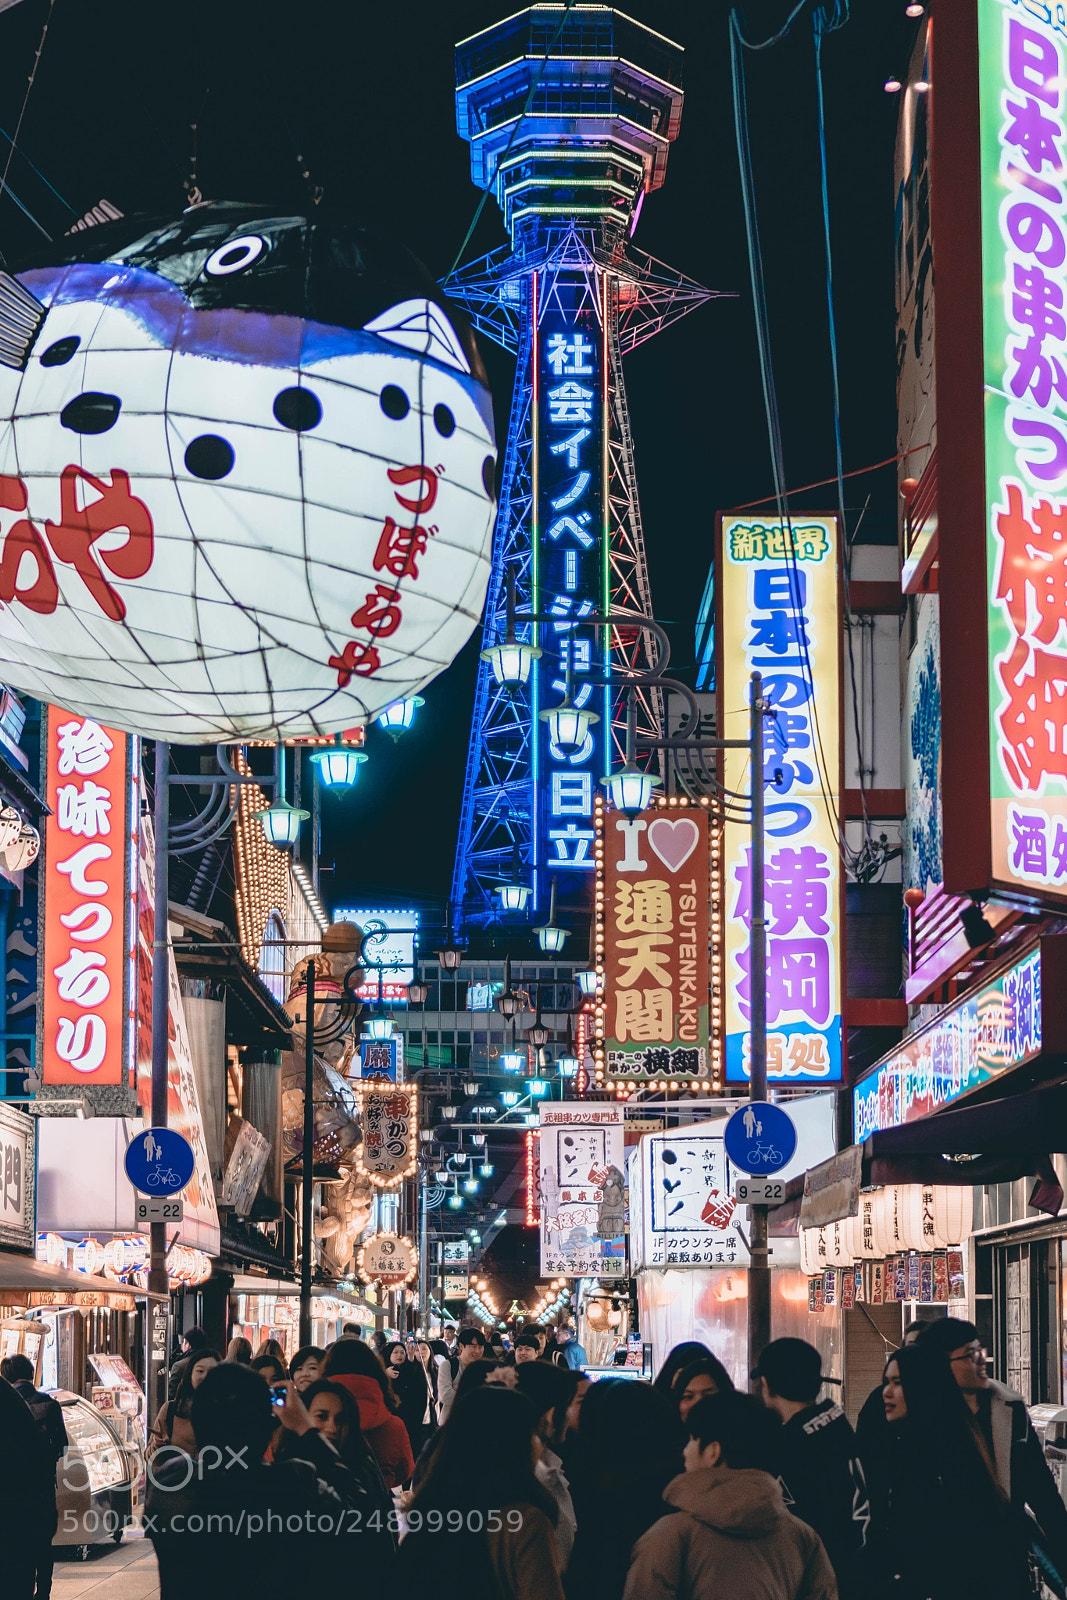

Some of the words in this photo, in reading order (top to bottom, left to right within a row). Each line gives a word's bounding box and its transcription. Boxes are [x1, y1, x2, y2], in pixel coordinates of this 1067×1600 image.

[730, 524, 828, 562] 新世界
[329, 463, 446, 688] づぼらや
[749, 567, 813, 838] 日本一の串かつ
[54, 718, 114, 1074] 珍味てっちり
[733, 846, 832, 1027] 横綱
[614, 879, 674, 1044] 通天閣
[678, 878, 697, 1041] TSUTENKAKU
[608, 1052, 642, 1061] 日本一の
[609, 1063, 642, 1074] 串かつ
[642, 1047, 700, 1075] 横綱
[384, 1093, 409, 1158] 串かつ
[545, 1112, 620, 1123] 元祖串カツ専門店
[667, 1252, 738, 1263] 座敷あります
[668, 1237, 737, 1249] カウンター席
[545, 1260, 622, 1272] 宴会予約受付中
